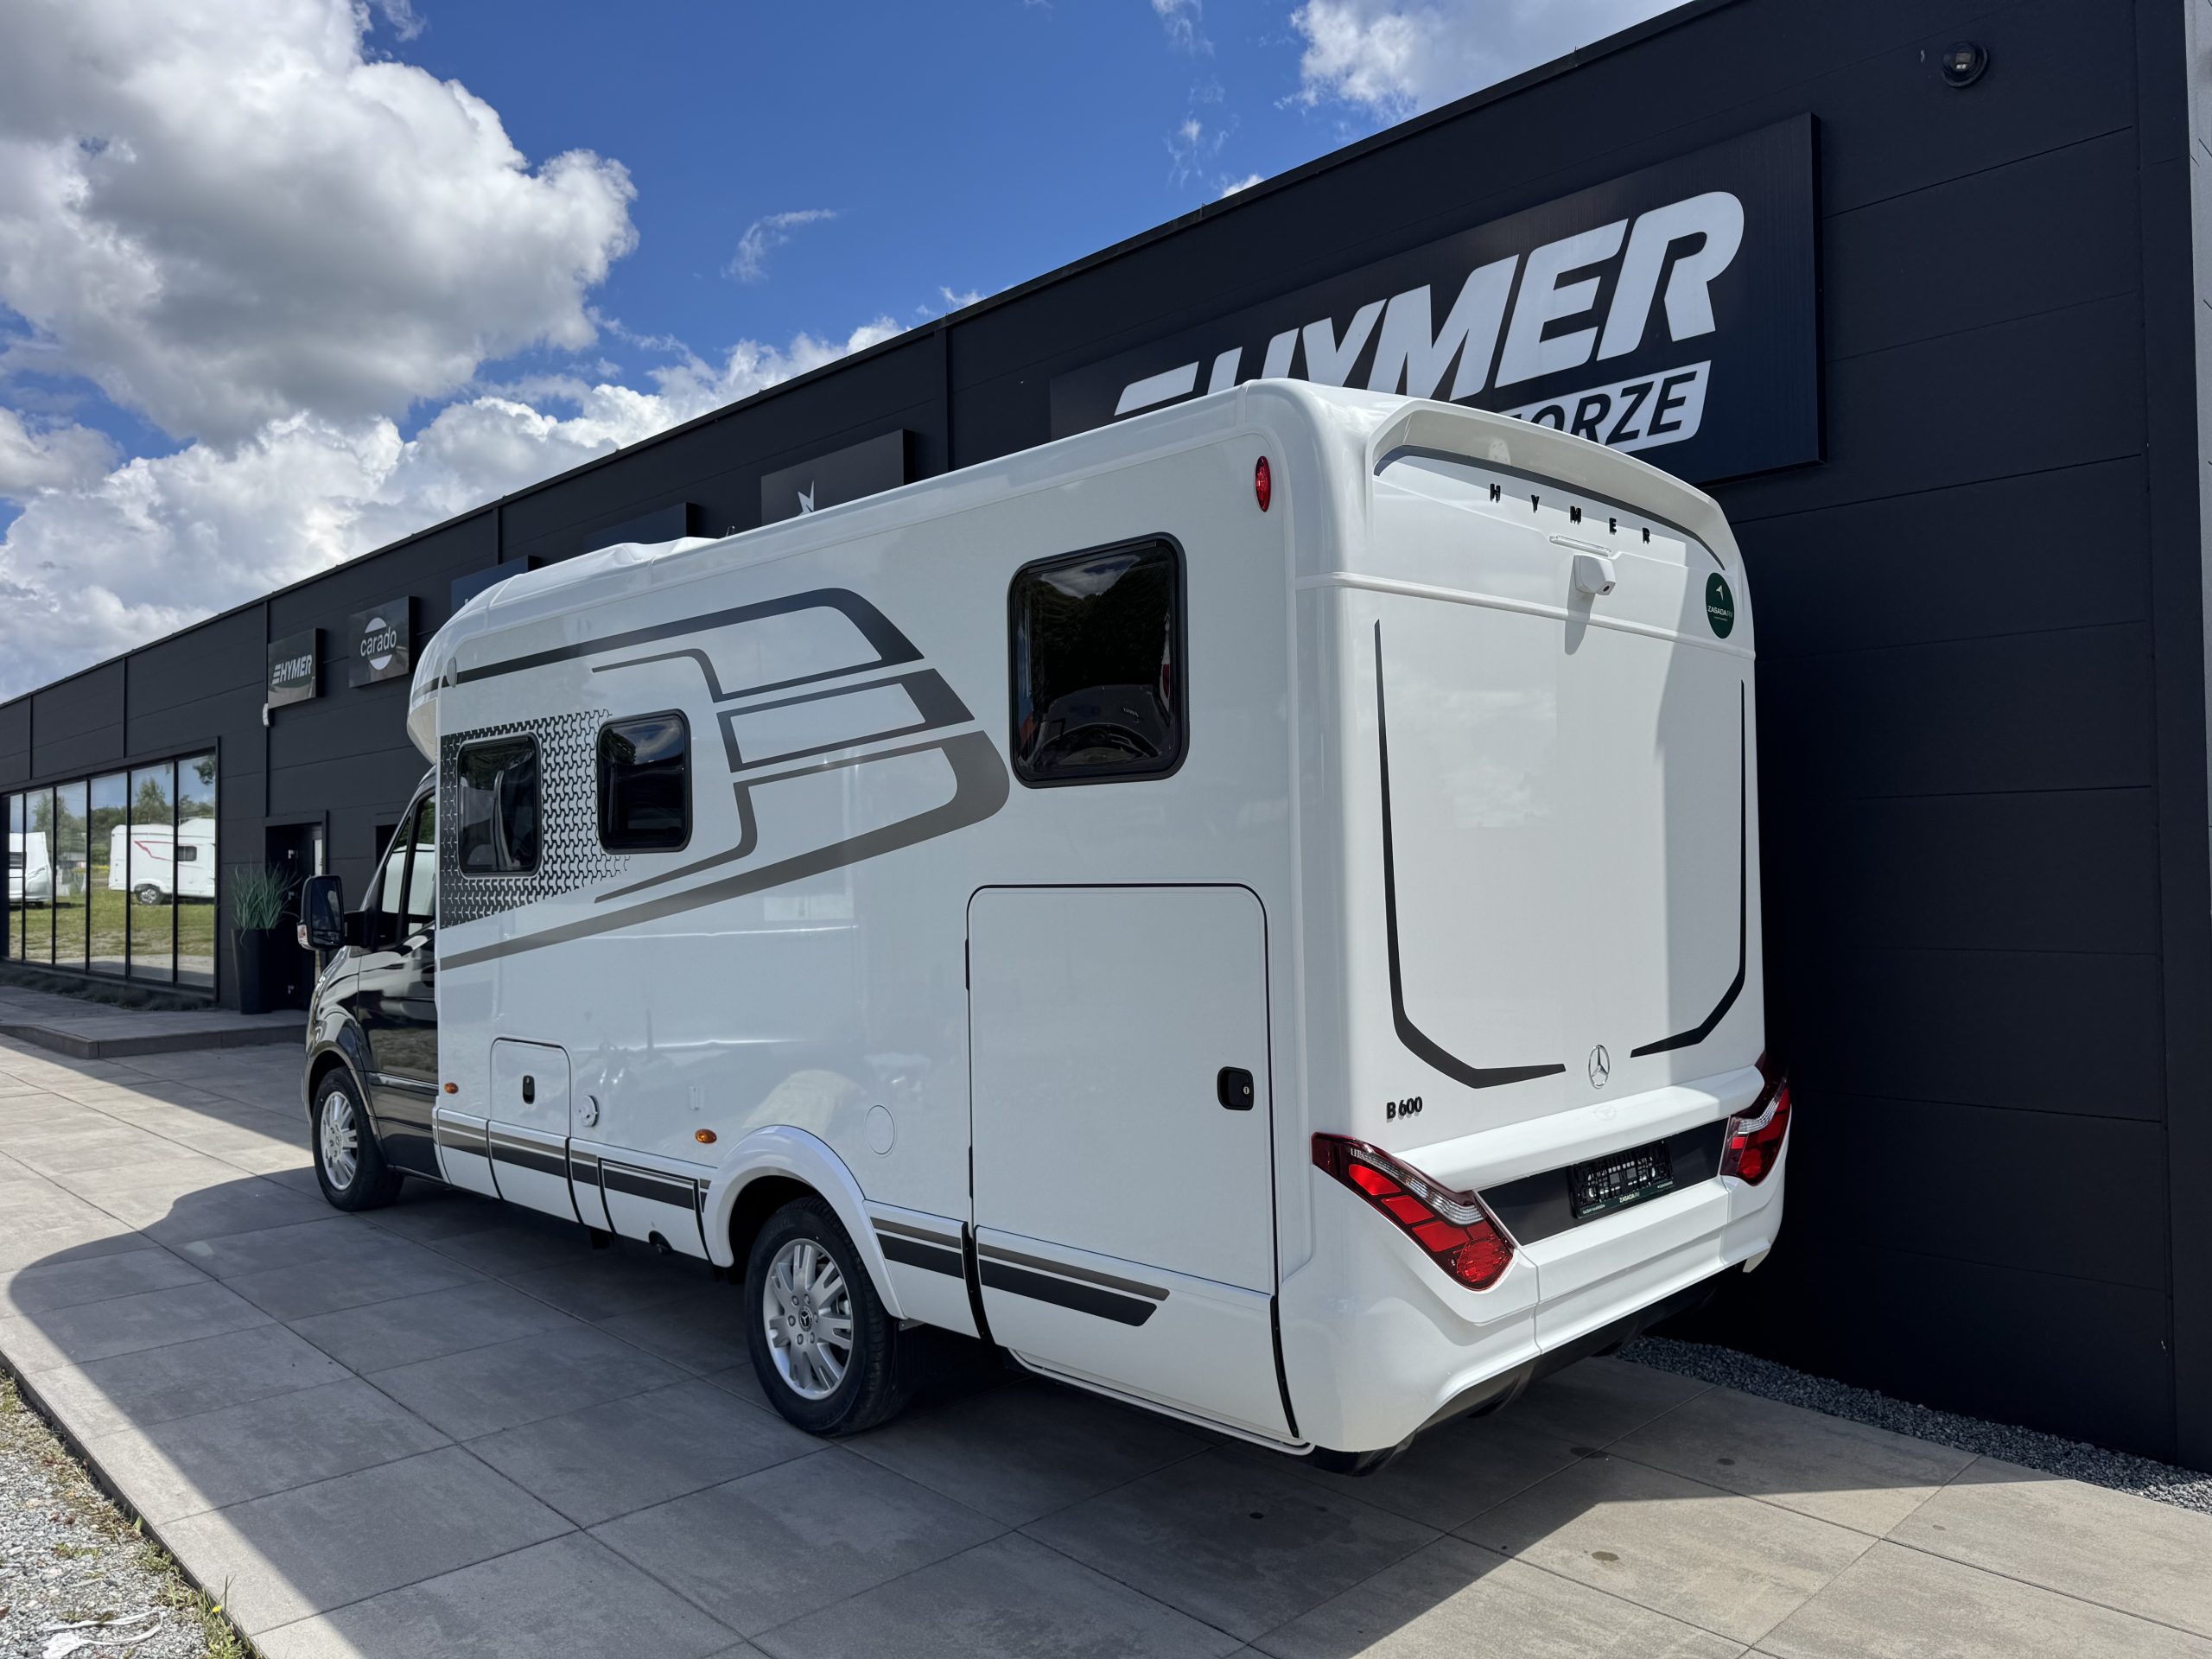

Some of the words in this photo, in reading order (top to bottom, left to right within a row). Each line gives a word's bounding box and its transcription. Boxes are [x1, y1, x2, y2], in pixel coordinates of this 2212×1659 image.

[1490, 483, 1650, 544] HYMER
[359, 626, 397, 657] carado
[278, 653, 313, 683] HYMER
[1386, 1101, 1396, 1120] B
[1398, 1096, 1423, 1116] 600
